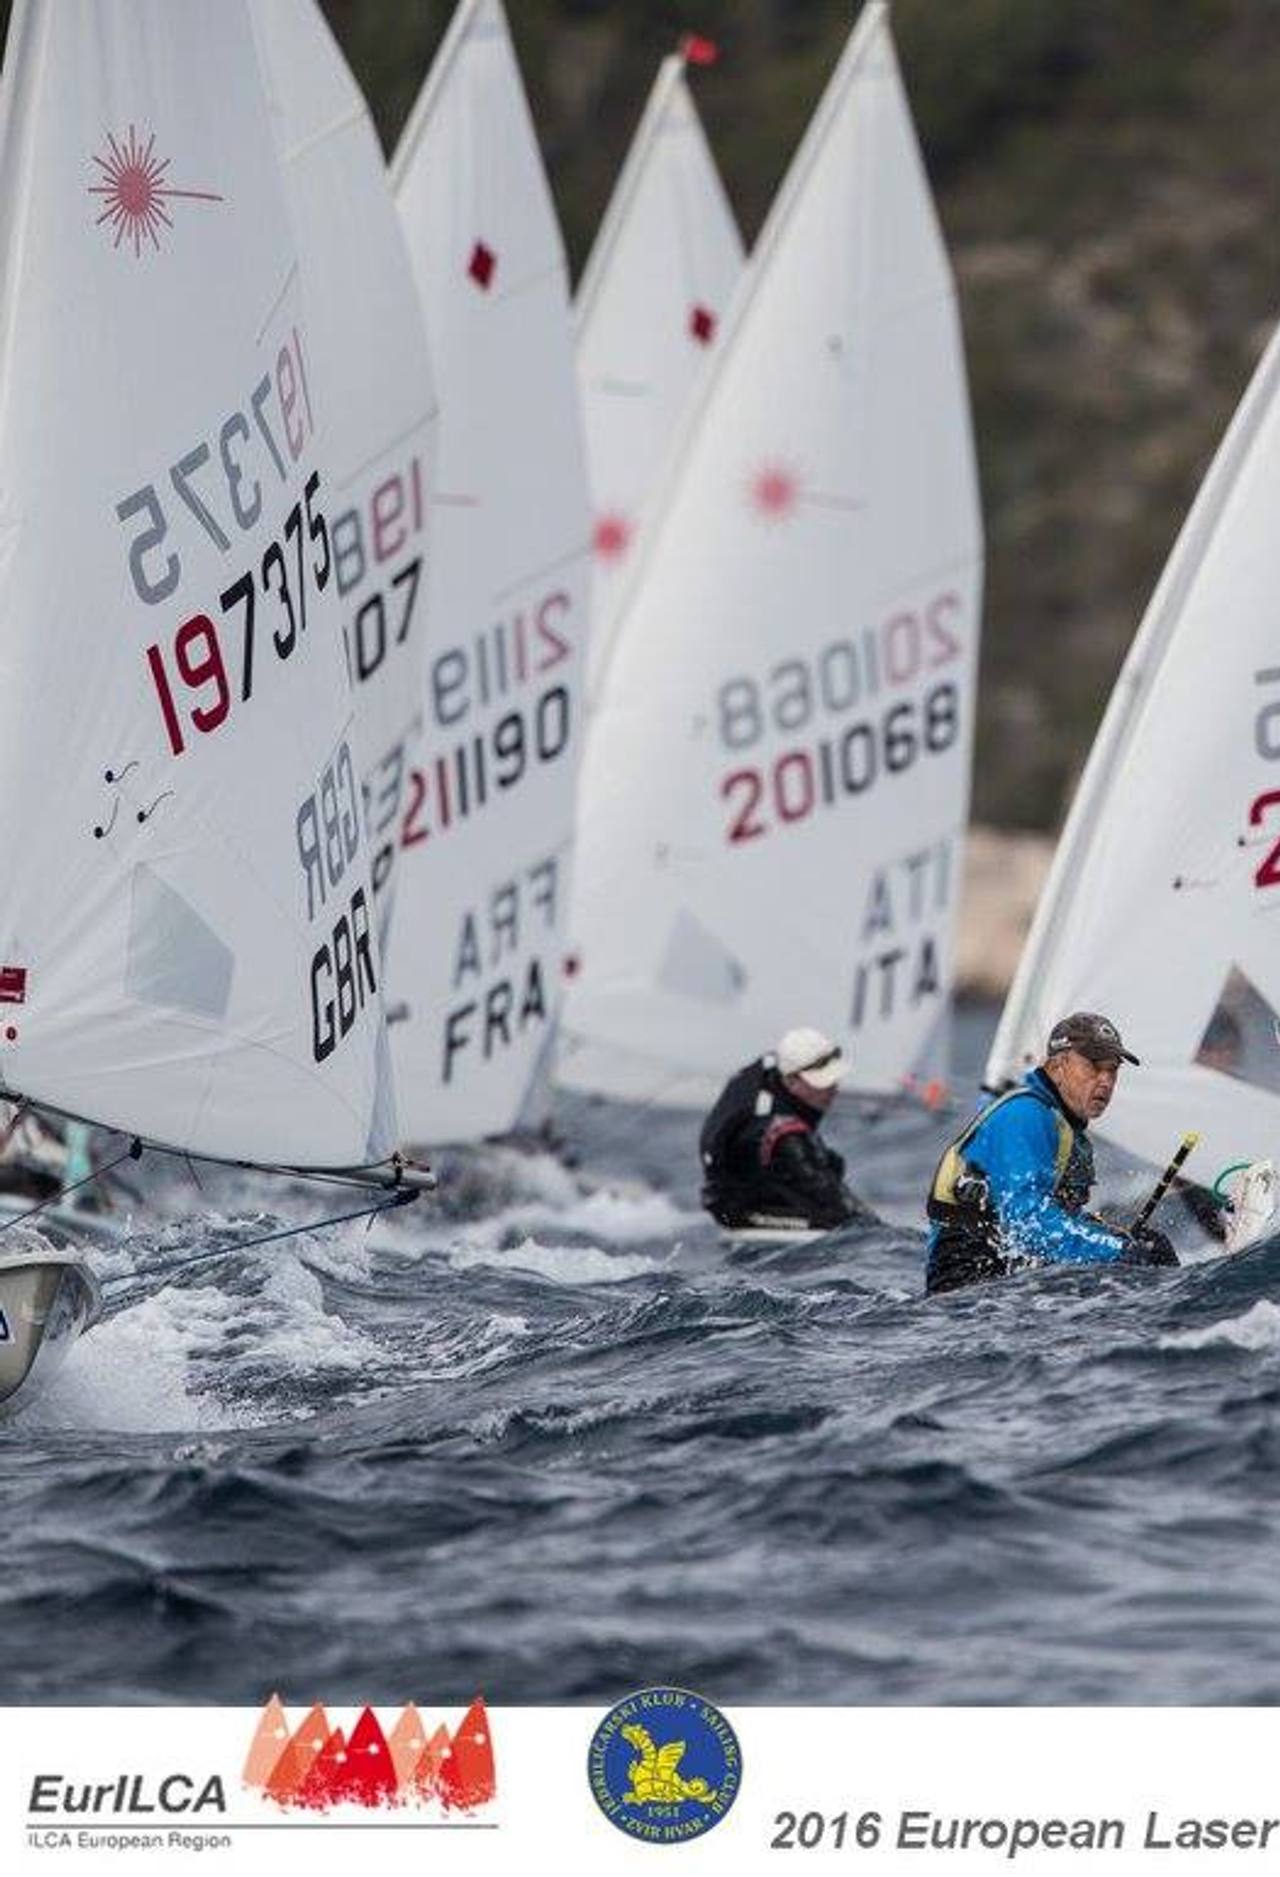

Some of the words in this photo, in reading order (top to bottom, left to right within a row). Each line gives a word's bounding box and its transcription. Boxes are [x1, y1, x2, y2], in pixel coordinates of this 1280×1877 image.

[147, 470, 331, 756] 197375
[401, 685, 571, 849] 211190
[719, 683, 959, 845] 201068
[310, 886, 378, 1064] GBR
[442, 961, 546, 1085] FRA
[851, 937, 943, 1028] ITA
